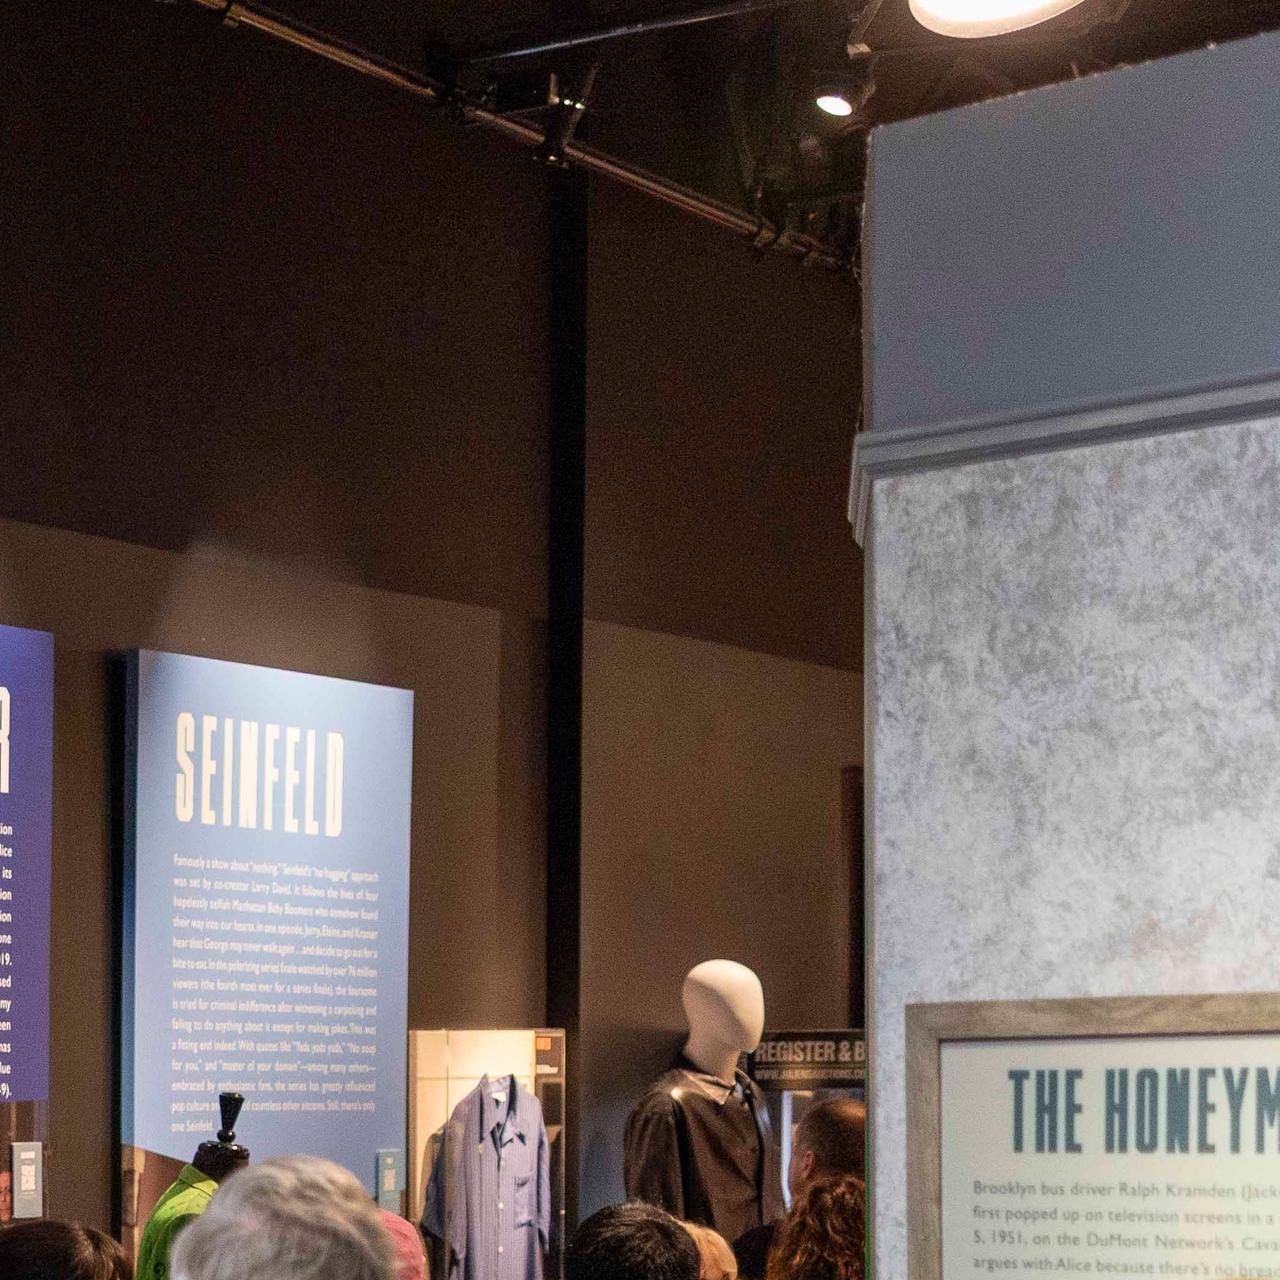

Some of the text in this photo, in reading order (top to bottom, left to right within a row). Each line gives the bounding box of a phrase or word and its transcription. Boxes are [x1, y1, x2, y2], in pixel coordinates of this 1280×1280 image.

[175, 711, 345, 838] SEINFELD
[756, 1040, 836, 1062] REGISTER
[838, 1040, 852, 1062] &
[1008, 1067, 1280, 1155] THE HONEYM
